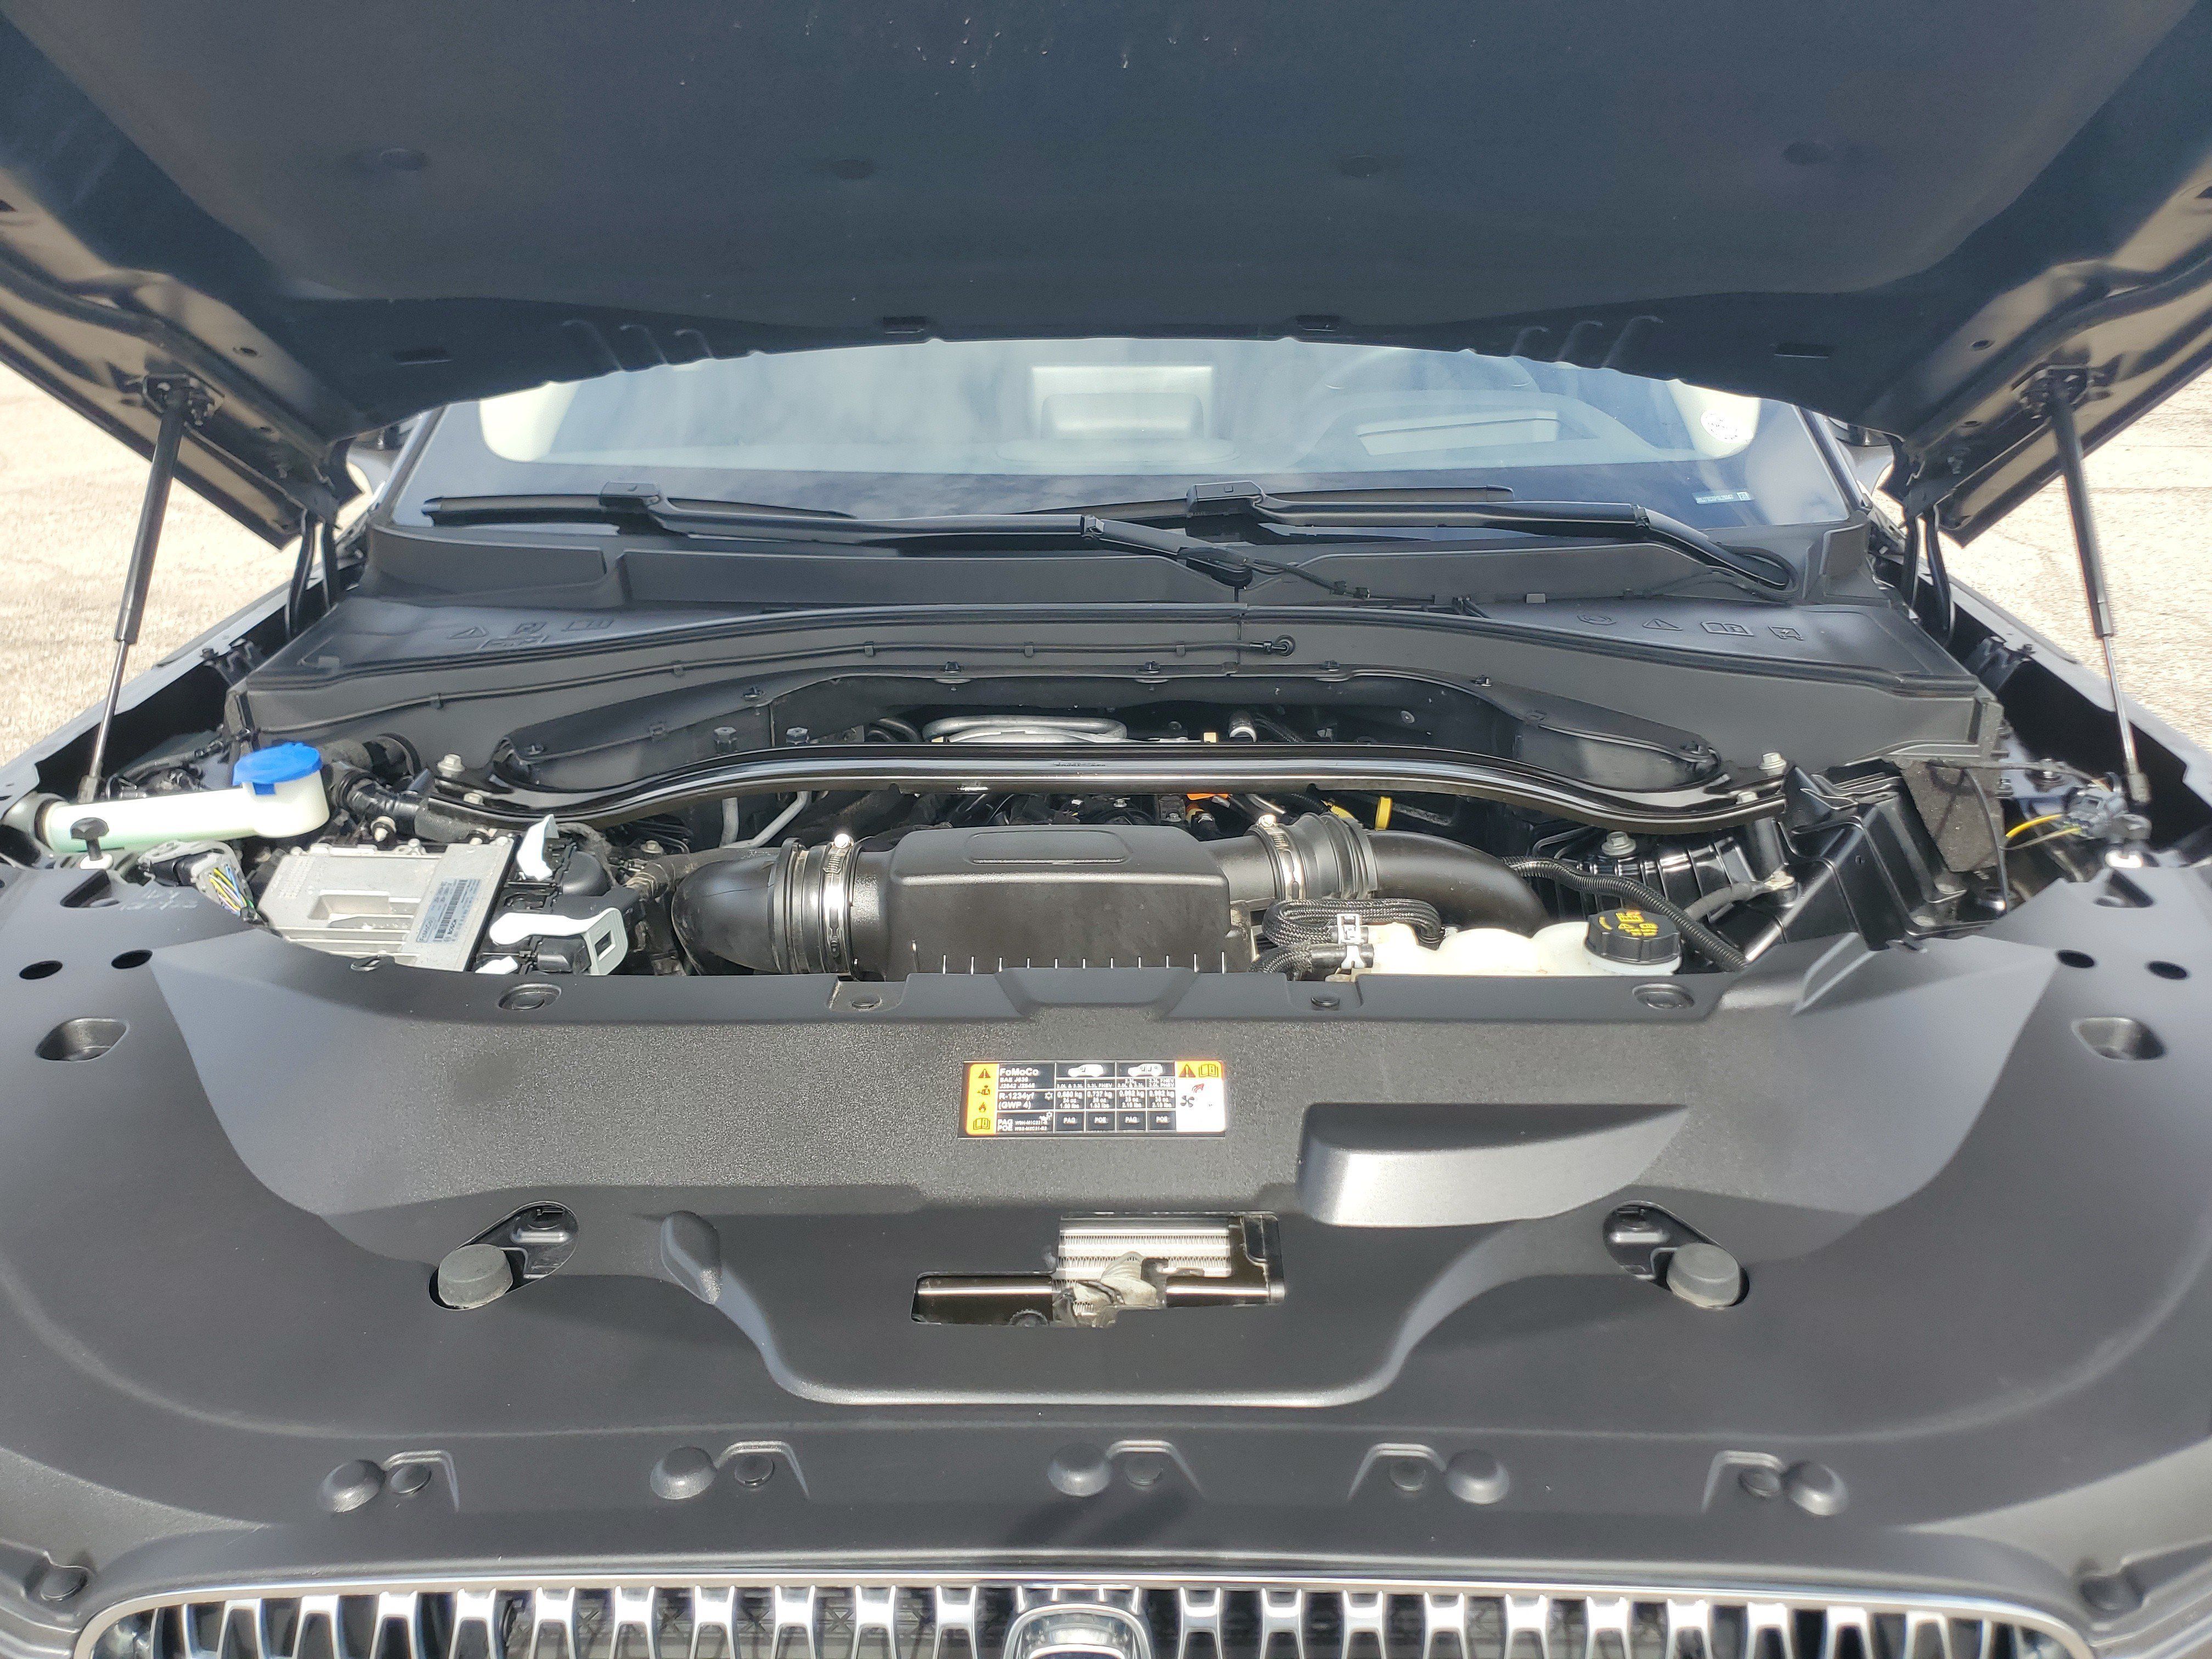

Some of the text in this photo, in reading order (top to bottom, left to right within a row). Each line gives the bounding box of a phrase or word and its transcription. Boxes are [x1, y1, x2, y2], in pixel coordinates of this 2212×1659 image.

[999, 1067, 1039, 1076] FoMoCo
[998, 1092, 1035, 1101] R-1234yf
[1075, 1091, 1082, 1099] kg
[1104, 1091, 1113, 1099] kg
[1137, 1090, 1144, 1098] kg
[1167, 1090, 1175, 1098] kg
[998, 1101, 1031, 1110] (GWP 4)
